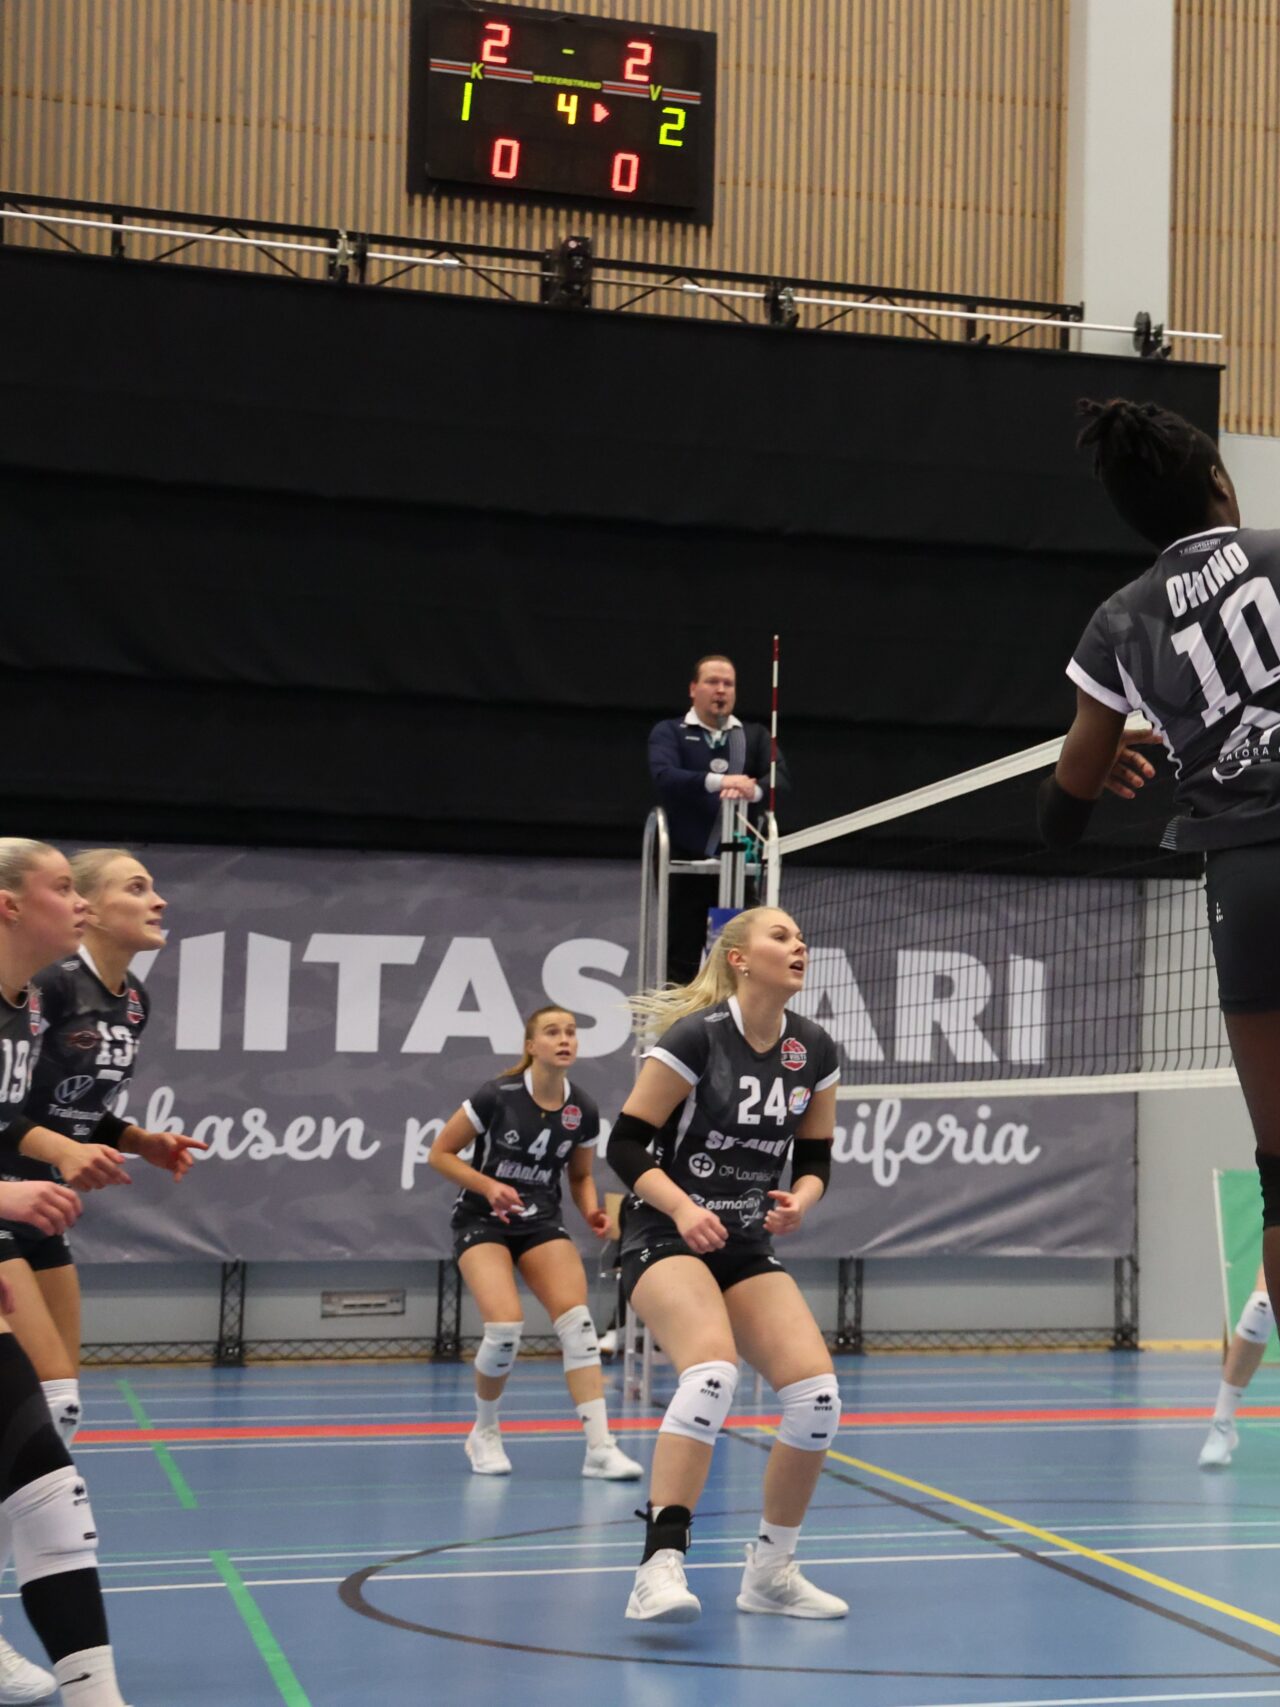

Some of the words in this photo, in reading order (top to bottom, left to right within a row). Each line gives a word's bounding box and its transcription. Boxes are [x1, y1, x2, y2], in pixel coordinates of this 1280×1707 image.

[482, 22, 511, 63] 2
[624, 41, 652, 82] 2
[470, 62, 484, 80] K
[649, 84, 662, 101] V
[556, 93, 578, 125] 4
[658, 106, 686, 147] 2
[491, 138, 520, 179] 0
[611, 152, 639, 193] 0
[1165, 541, 1250, 618] OWINO
[128, 929, 1046, 1066] IITASARI
[0, 1038, 30, 1103] 19
[737, 1075, 788, 1126] 24
[527, 1128, 552, 1161] 4
[832, 1099, 1042, 1187] iferia
